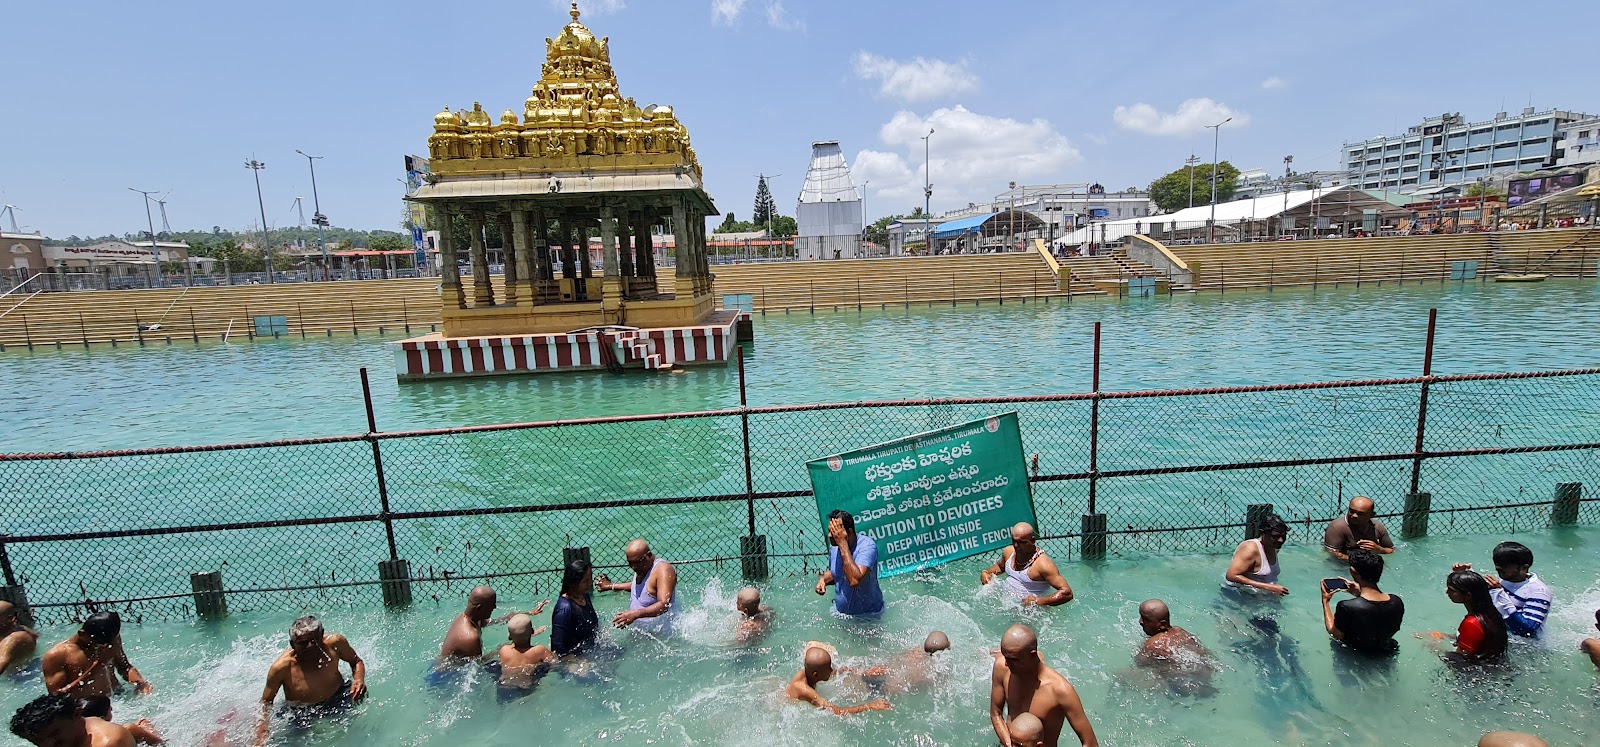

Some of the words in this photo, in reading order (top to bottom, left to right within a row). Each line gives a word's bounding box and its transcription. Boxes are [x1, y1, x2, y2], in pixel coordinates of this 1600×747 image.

[845, 453, 876, 466] TIRUMALA
[877, 445, 903, 458] TIRUPATI
[954, 426, 985, 439] TIRUMALA
[865, 456, 917, 482] భక్తులకు
[918, 441, 972, 466] హెచ్చరిక
[852, 503, 897, 524] ంచెదాటి
[917, 513, 935, 528] TO
[937, 495, 1004, 524] DEVOTEES
[886, 537, 912, 555] DEEP
[913, 528, 947, 547] WELLS
[947, 519, 982, 538] INSIDE
[886, 552, 917, 570] ENTER
[918, 541, 959, 562] BEYOND
[959, 535, 980, 551] THE
